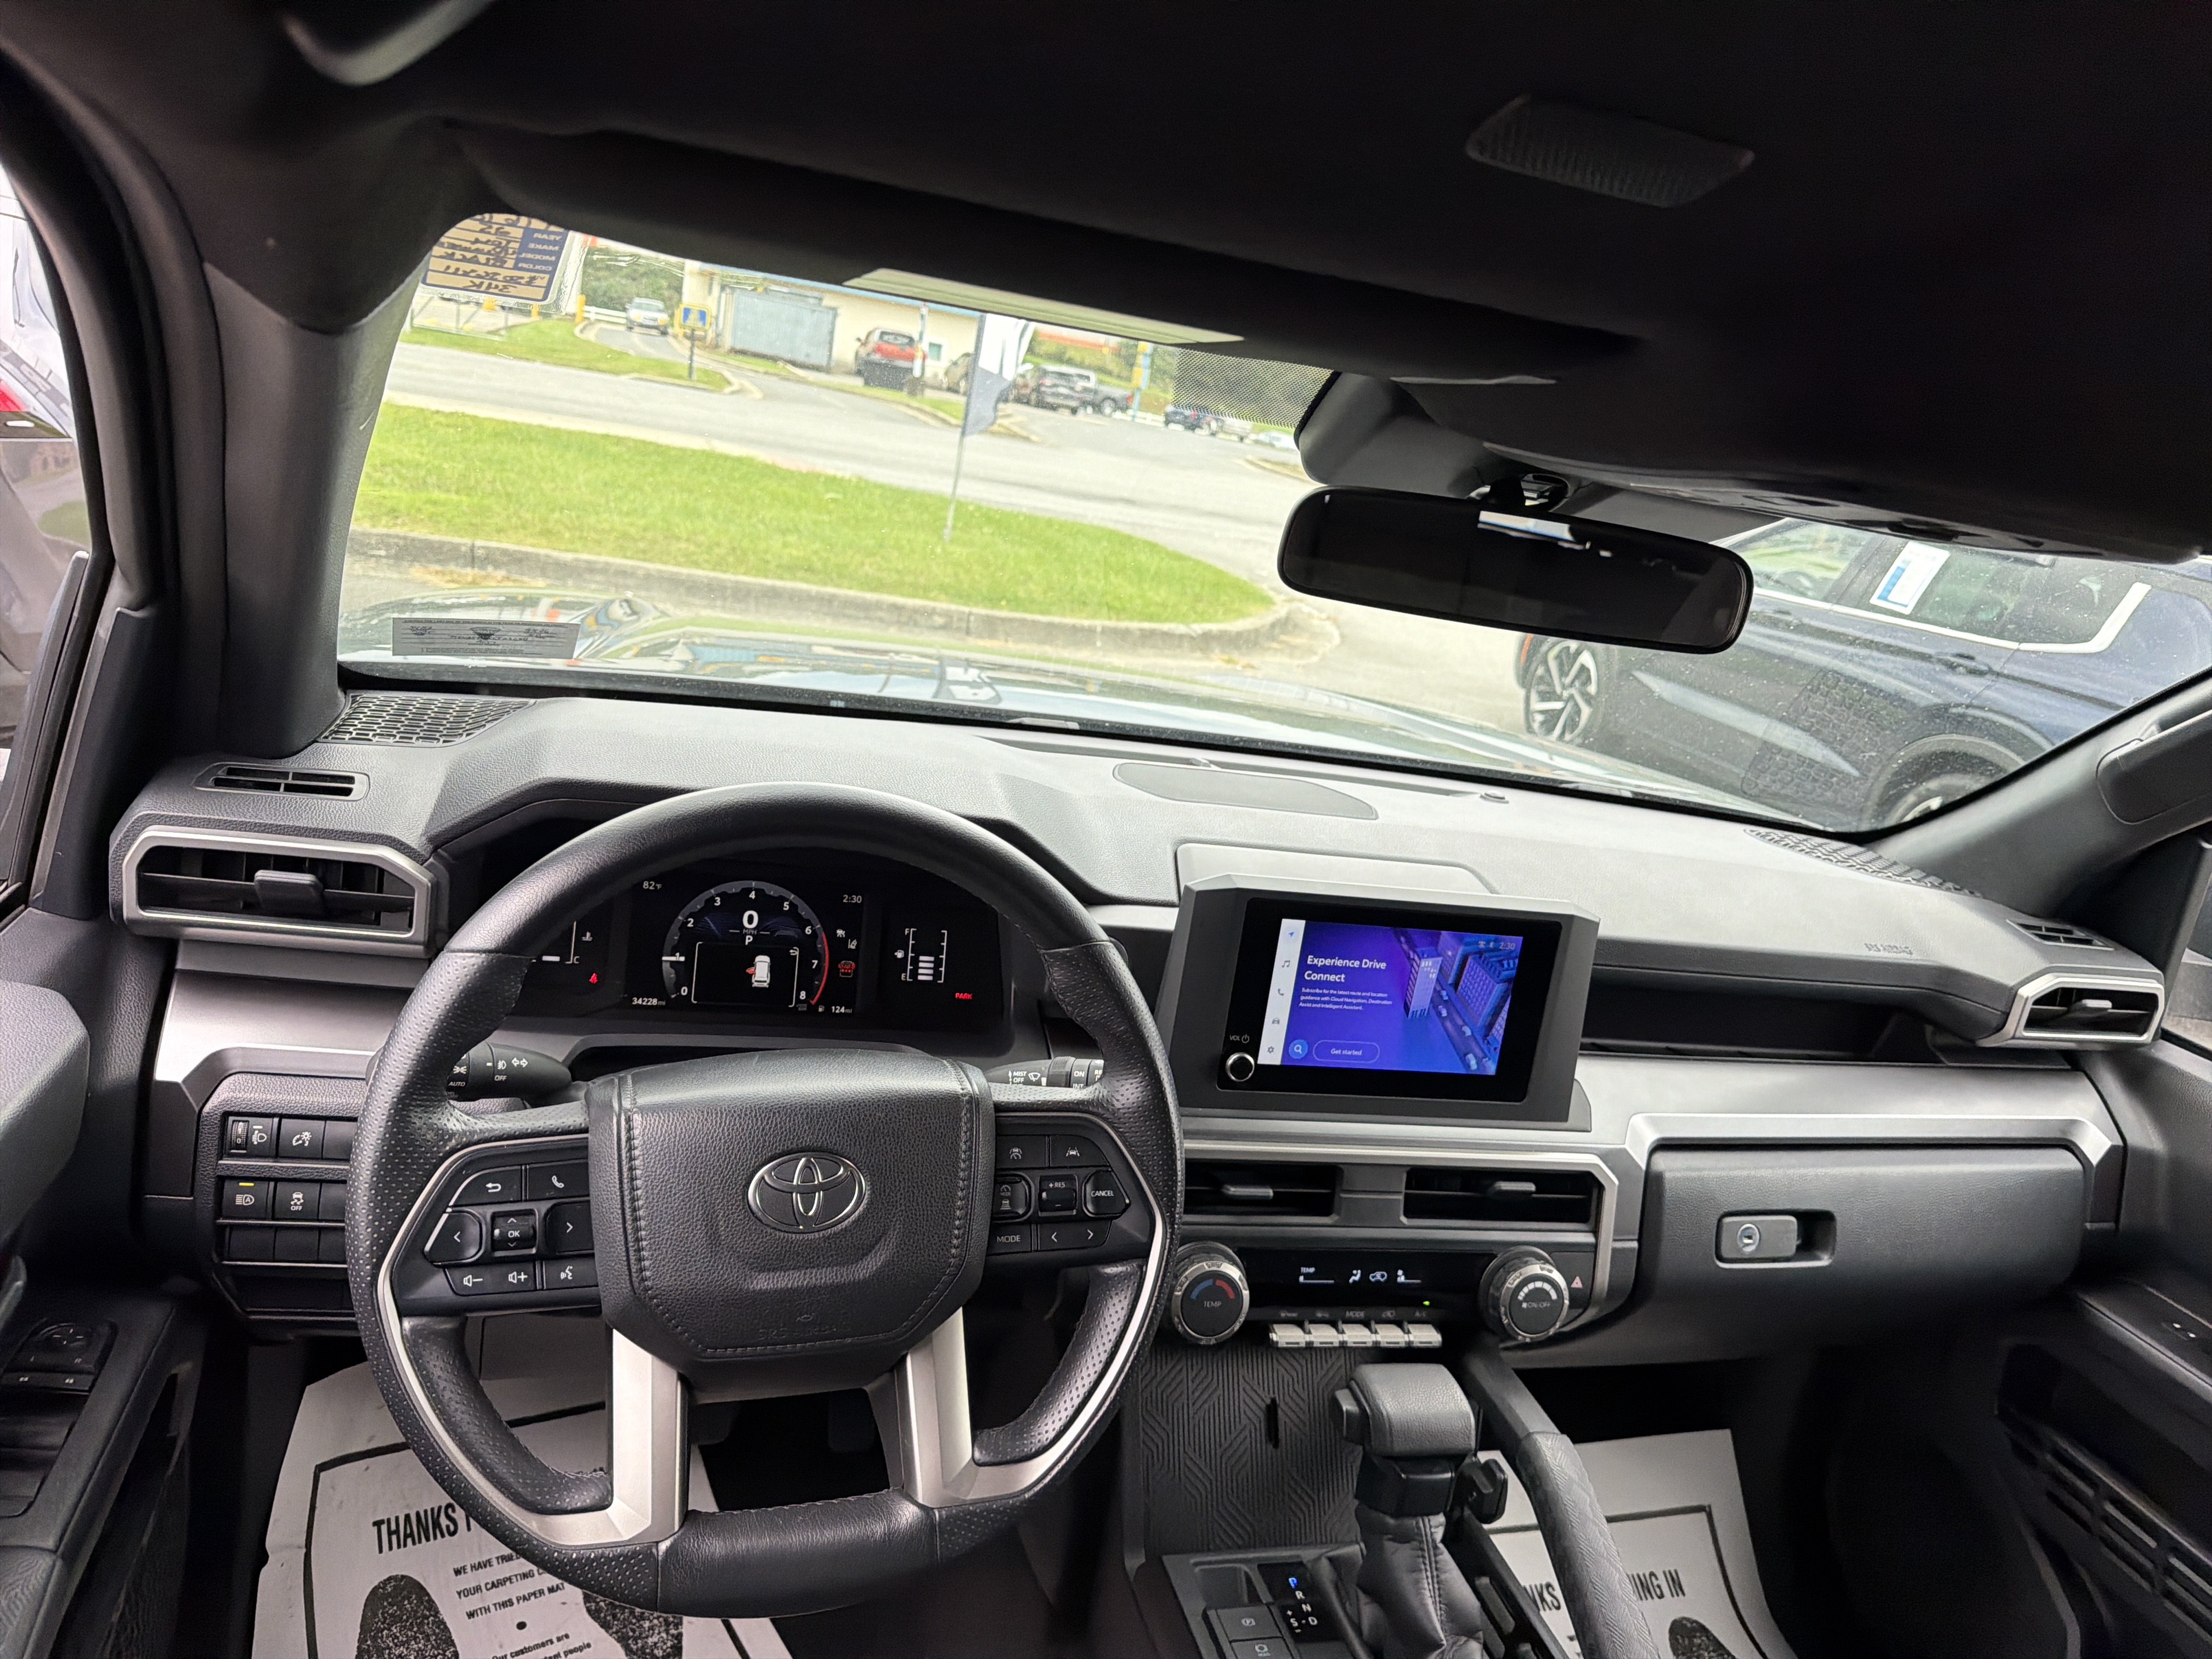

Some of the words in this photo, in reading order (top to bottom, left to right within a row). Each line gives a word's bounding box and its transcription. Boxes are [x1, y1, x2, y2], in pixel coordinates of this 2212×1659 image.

[749, 890, 755, 899] 4
[843, 894, 862, 904] 2:30
[714, 897, 721, 906] 3
[783, 902, 789, 911] 5
[687, 918, 694, 927] 2
[742, 910, 759, 929] 0
[805, 926, 812, 935] 6
[745, 935, 753, 946] P
[1499, 941, 1516, 950] 2:30
[573, 956, 579, 964] C
[675, 952, 680, 961] 1
[812, 960, 819, 969] 7
[1307, 955, 1360, 968] Experience
[1362, 958, 1387, 970] Drive
[901, 973, 906, 981] E
[1304, 970, 1346, 983] Connect
[680, 987, 688, 996] 0
[799, 990, 806, 1000] 8
[996, 1234, 1021, 1243] MODE
[1203, 1300, 1222, 1308] TEMP
[372, 1502, 459, 1554] THANKS
[453, 1566, 467, 1577] WE
[470, 1558, 494, 1572] HAVE
[456, 1584, 482, 1600] YOUR
[484, 1568, 535, 1591] CARPETING
[1288, 1577, 1299, 1589] P
[1662, 1568, 1686, 1599] IN
[1295, 1590, 1305, 1600] R
[465, 1605, 491, 1620] WITH
[492, 1597, 514, 1612] THIS
[516, 1587, 545, 1605] PAPER
[546, 1582, 566, 1595] MAT
[1302, 1604, 1312, 1612] N
[1290, 1617, 1299, 1627] S
[1308, 1617, 1318, 1626] D
[510, 1638, 555, 1658] customers
[556, 1633, 570, 1643] are
[563, 1642, 592, 1657] people
